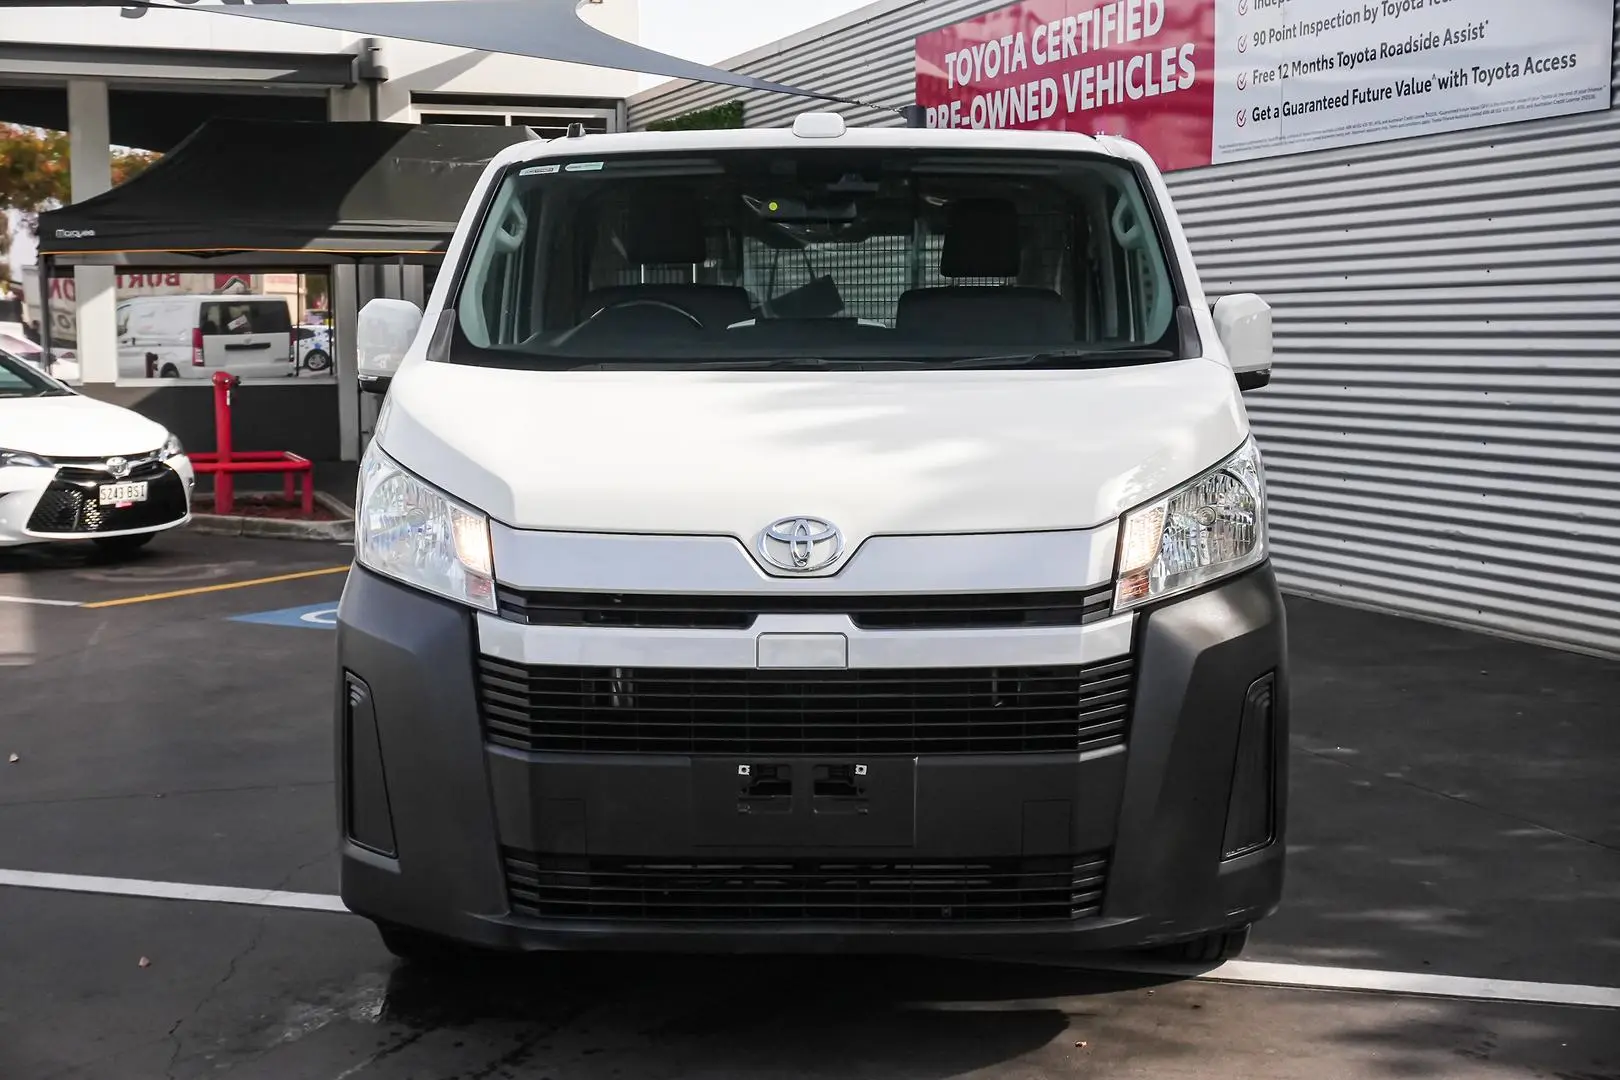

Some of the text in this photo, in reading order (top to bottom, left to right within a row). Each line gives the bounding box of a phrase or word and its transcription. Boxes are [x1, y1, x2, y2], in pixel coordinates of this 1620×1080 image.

[944, 0, 1165, 89] TOYOTA CERTIFIED
[1252, 69, 1275, 85] Free
[1278, 63, 1289, 80] 12
[1291, 54, 1334, 77] Months
[1337, 47, 1377, 69] Toyota
[1380, 31, 1440, 59] Roadside
[1253, 0, 1424, 47] 90 Point Inspection by Toyota
[926, 43, 1196, 129] PRE-OWNED VEHICLES
[1252, 105, 1271, 122] Get
[1273, 107, 1280, 118] a
[1282, 89, 1349, 117] Guaranteed
[1352, 86, 1392, 105] Future
[1438, 68, 1468, 90] with
[1472, 62, 1520, 87] Toyota
[1523, 53, 1577, 76] Access
